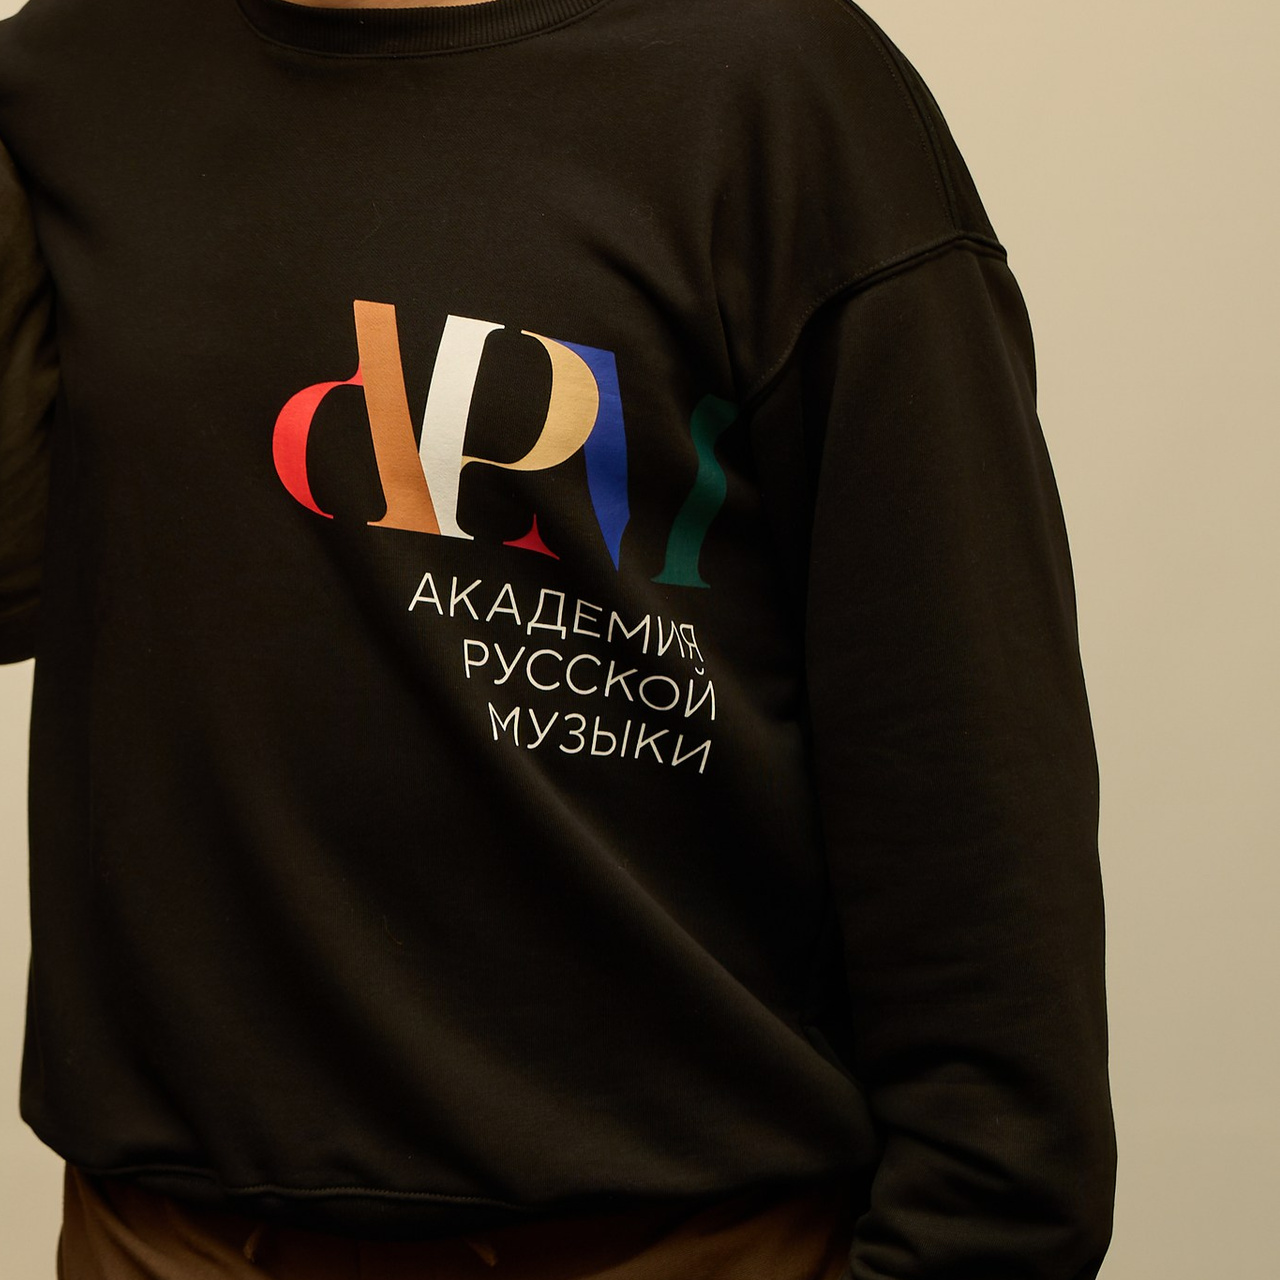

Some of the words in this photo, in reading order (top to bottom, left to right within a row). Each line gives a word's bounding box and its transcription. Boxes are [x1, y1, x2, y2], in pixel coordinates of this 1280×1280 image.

[407, 572, 705, 663] АКАДЕМИЯ
[463, 638, 717, 721] РУССКОЙ
[488, 701, 712, 774] МУЗЫКИ
